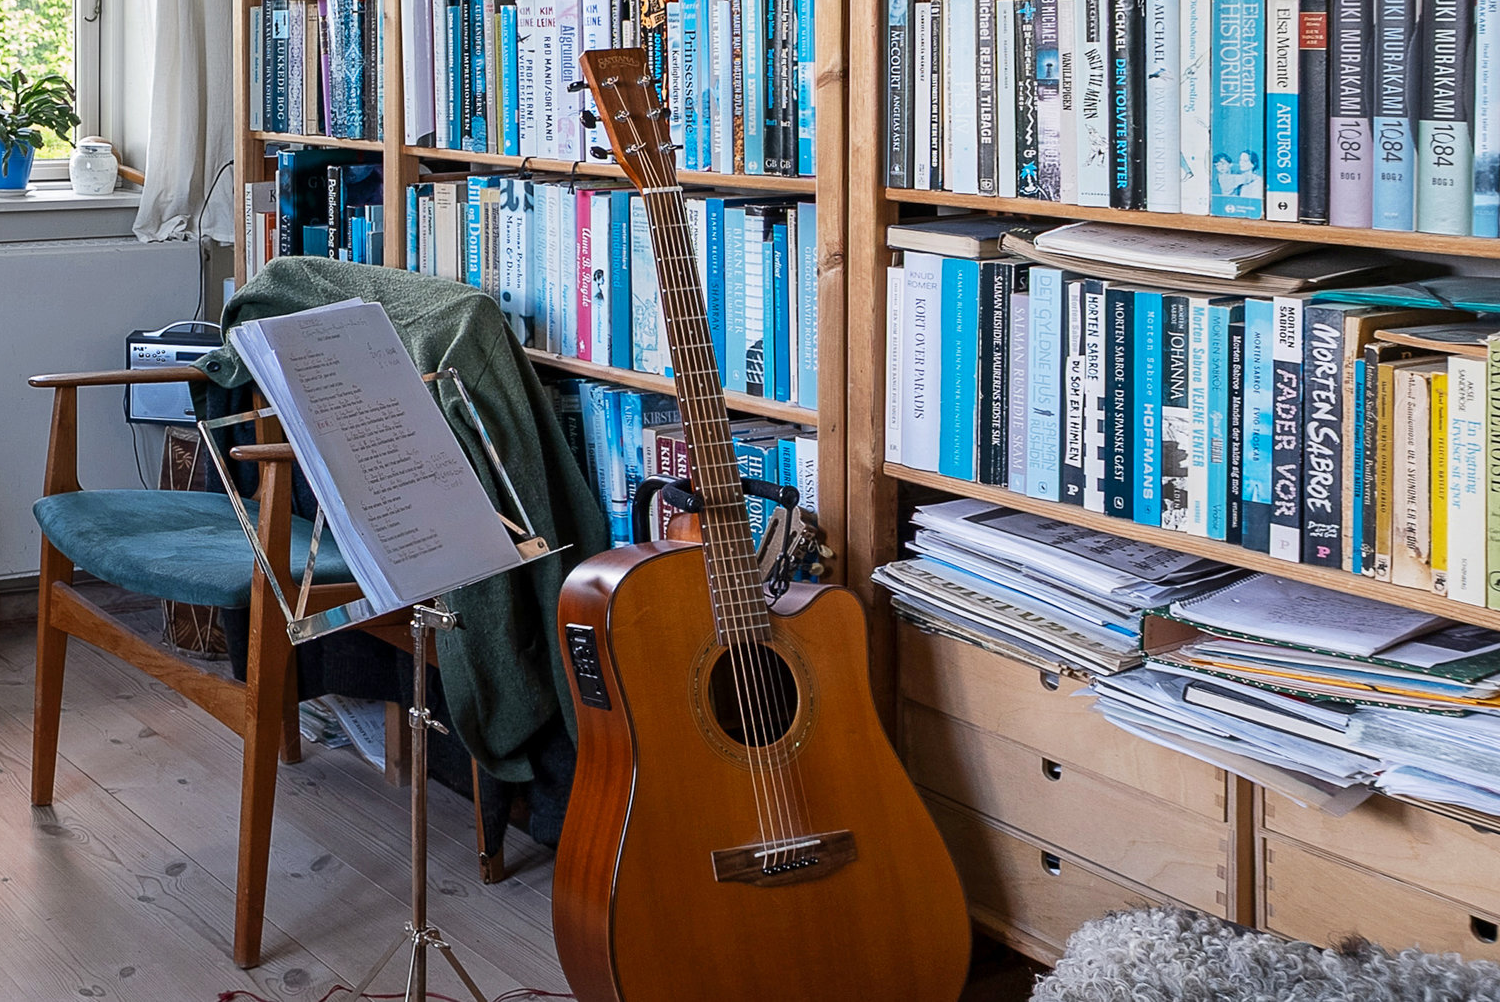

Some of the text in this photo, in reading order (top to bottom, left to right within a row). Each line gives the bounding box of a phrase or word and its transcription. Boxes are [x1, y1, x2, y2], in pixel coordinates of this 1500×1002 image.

[536, 19, 556, 28] LEINE
[540, 7, 554, 15] KIM
[558, 24, 576, 83] Afgrunden
[979, 47, 992, 93] REJSEN
[1114, 58, 1127, 86] DEN
[1219, 2, 1241, 108] HISTORIEN
[1242, 1, 1259, 107] Elsa Morante
[1276, 8, 1291, 89] Elsa Morante
[1339, 30, 1362, 116] MURAKAMI
[1382, 26, 1405, 115] MURAKAMI
[276, 40, 285, 120] LUKKEDE BOG
[683, 29, 696, 134] Prinsesserne
[890, 29, 902, 153] McCOURT ANGELAS ASKE
[1062, 51, 1072, 111] VANILLEPIGEN
[1433, 30, 1456, 119] MURAKAMI
[979, 96, 992, 145] TILBAGE
[1115, 87, 1127, 137] TOLVTE
[1116, 138, 1128, 190] RYTTER
[1276, 102, 1291, 185] ARTUROS Ø
[1337, 120, 1362, 163] 1Q84
[1380, 120, 1404, 163] 1Q84
[1431, 124, 1455, 167] 1Q84
[469, 181, 480, 205] Jill
[1340, 172, 1355, 180] BOG
[1381, 173, 1395, 181] BOG
[1431, 177, 1446, 187] BOG
[328, 178, 337, 250] Politikens bog
[710, 212, 718, 242] BJARNE
[468, 222, 481, 273] Donna
[581, 228, 592, 254] Anne
[505, 259, 513, 287] Dixon
[580, 272, 592, 308] Ragde
[710, 283, 720, 331] SHAMRAN
[1279, 305, 1287, 345] SABROE
[1286, 306, 1295, 348] MORTEN
[914, 298, 926, 422] KORT OVER PARADIS
[991, 275, 1002, 446] SALMAN RUSHDIE MAURERENS SIDSTE SUK
[1087, 296, 1099, 381] MORTEN SABROE
[1011, 306, 1026, 470] SALMAN RUSHDIE SKAM
[1071, 375, 1081, 398] SOM
[1072, 360, 1081, 373] DU
[1169, 331, 1184, 400] JOHANNA
[1312, 323, 1341, 423] MORTEN
[1114, 301, 1125, 482] MORTEN SABROE DEN SPANSKE GÆST
[1069, 421, 1079, 462] HIMLEN
[1143, 403, 1154, 499] HOFFMANS
[1274, 368, 1298, 516] FADER VOR
[1306, 421, 1340, 513] SABROE
